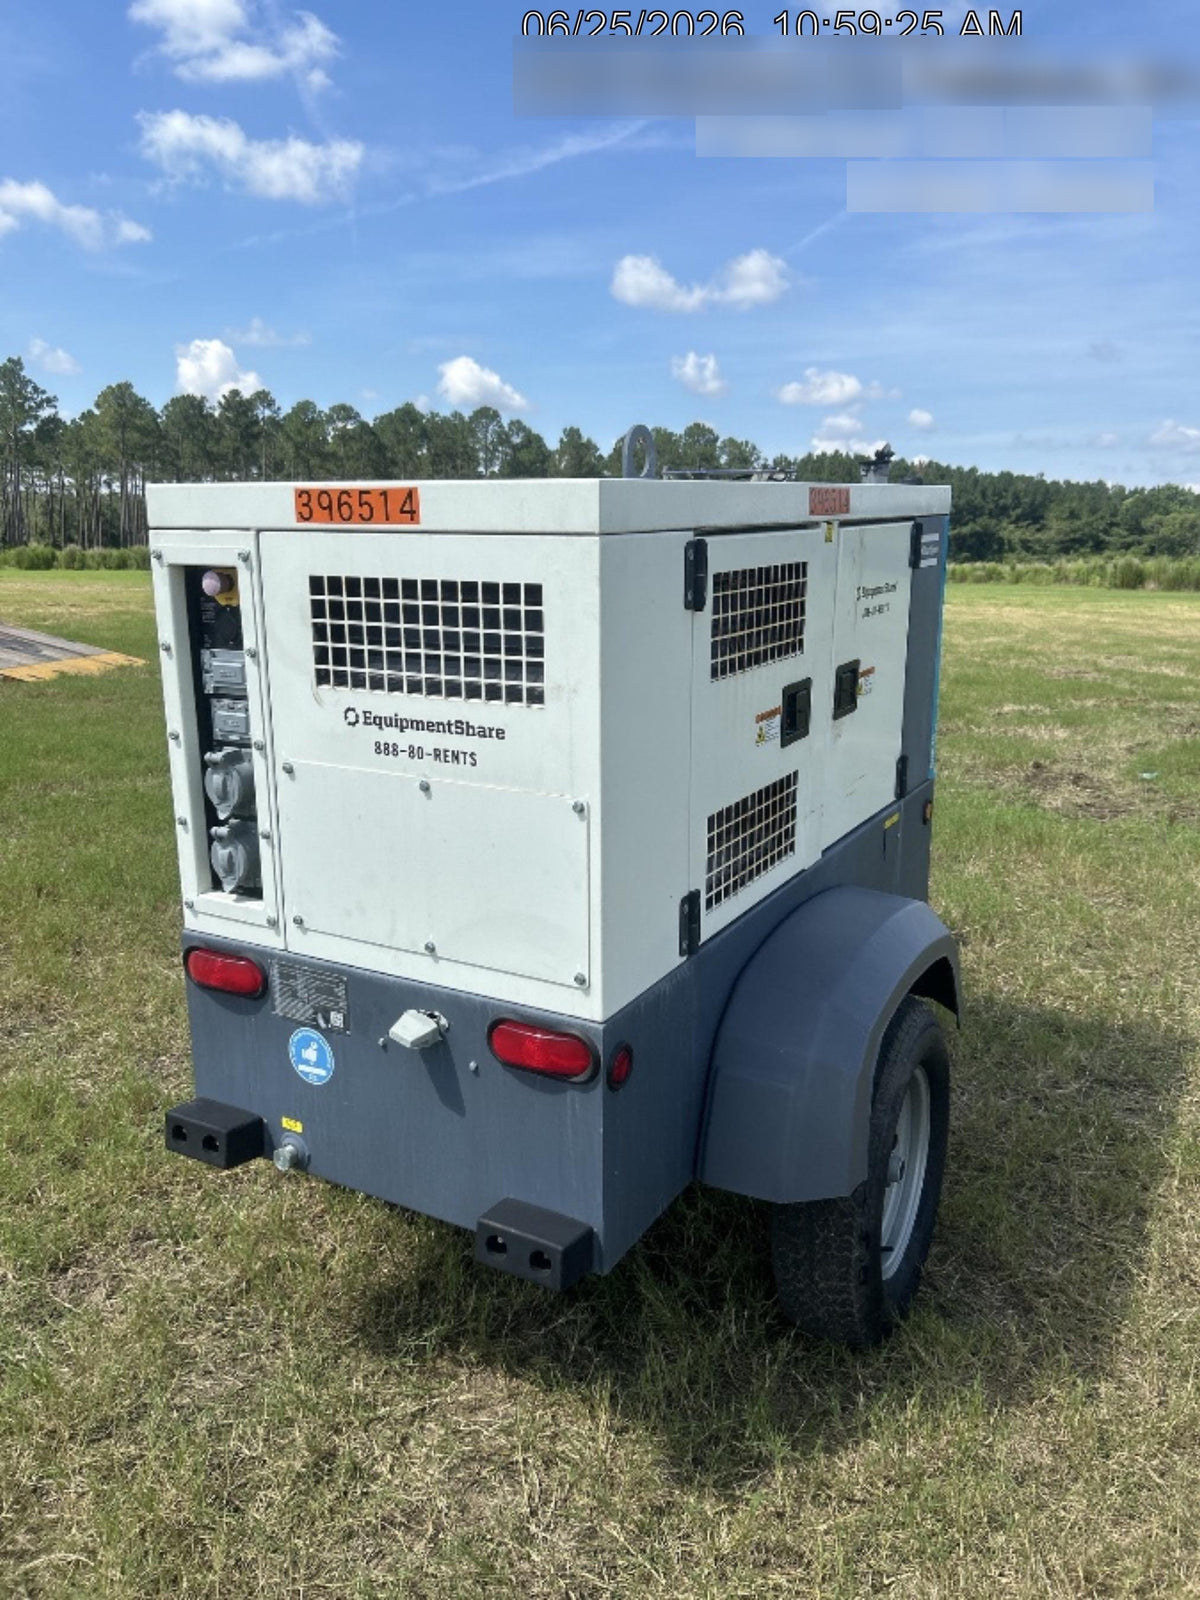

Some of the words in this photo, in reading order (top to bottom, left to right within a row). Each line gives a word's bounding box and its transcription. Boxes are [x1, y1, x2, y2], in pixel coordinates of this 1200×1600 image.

[297, 489, 416, 522] 396514
[362, 710, 506, 740] EquipmentShare
[374, 741, 478, 767] 888-80-RENTS
